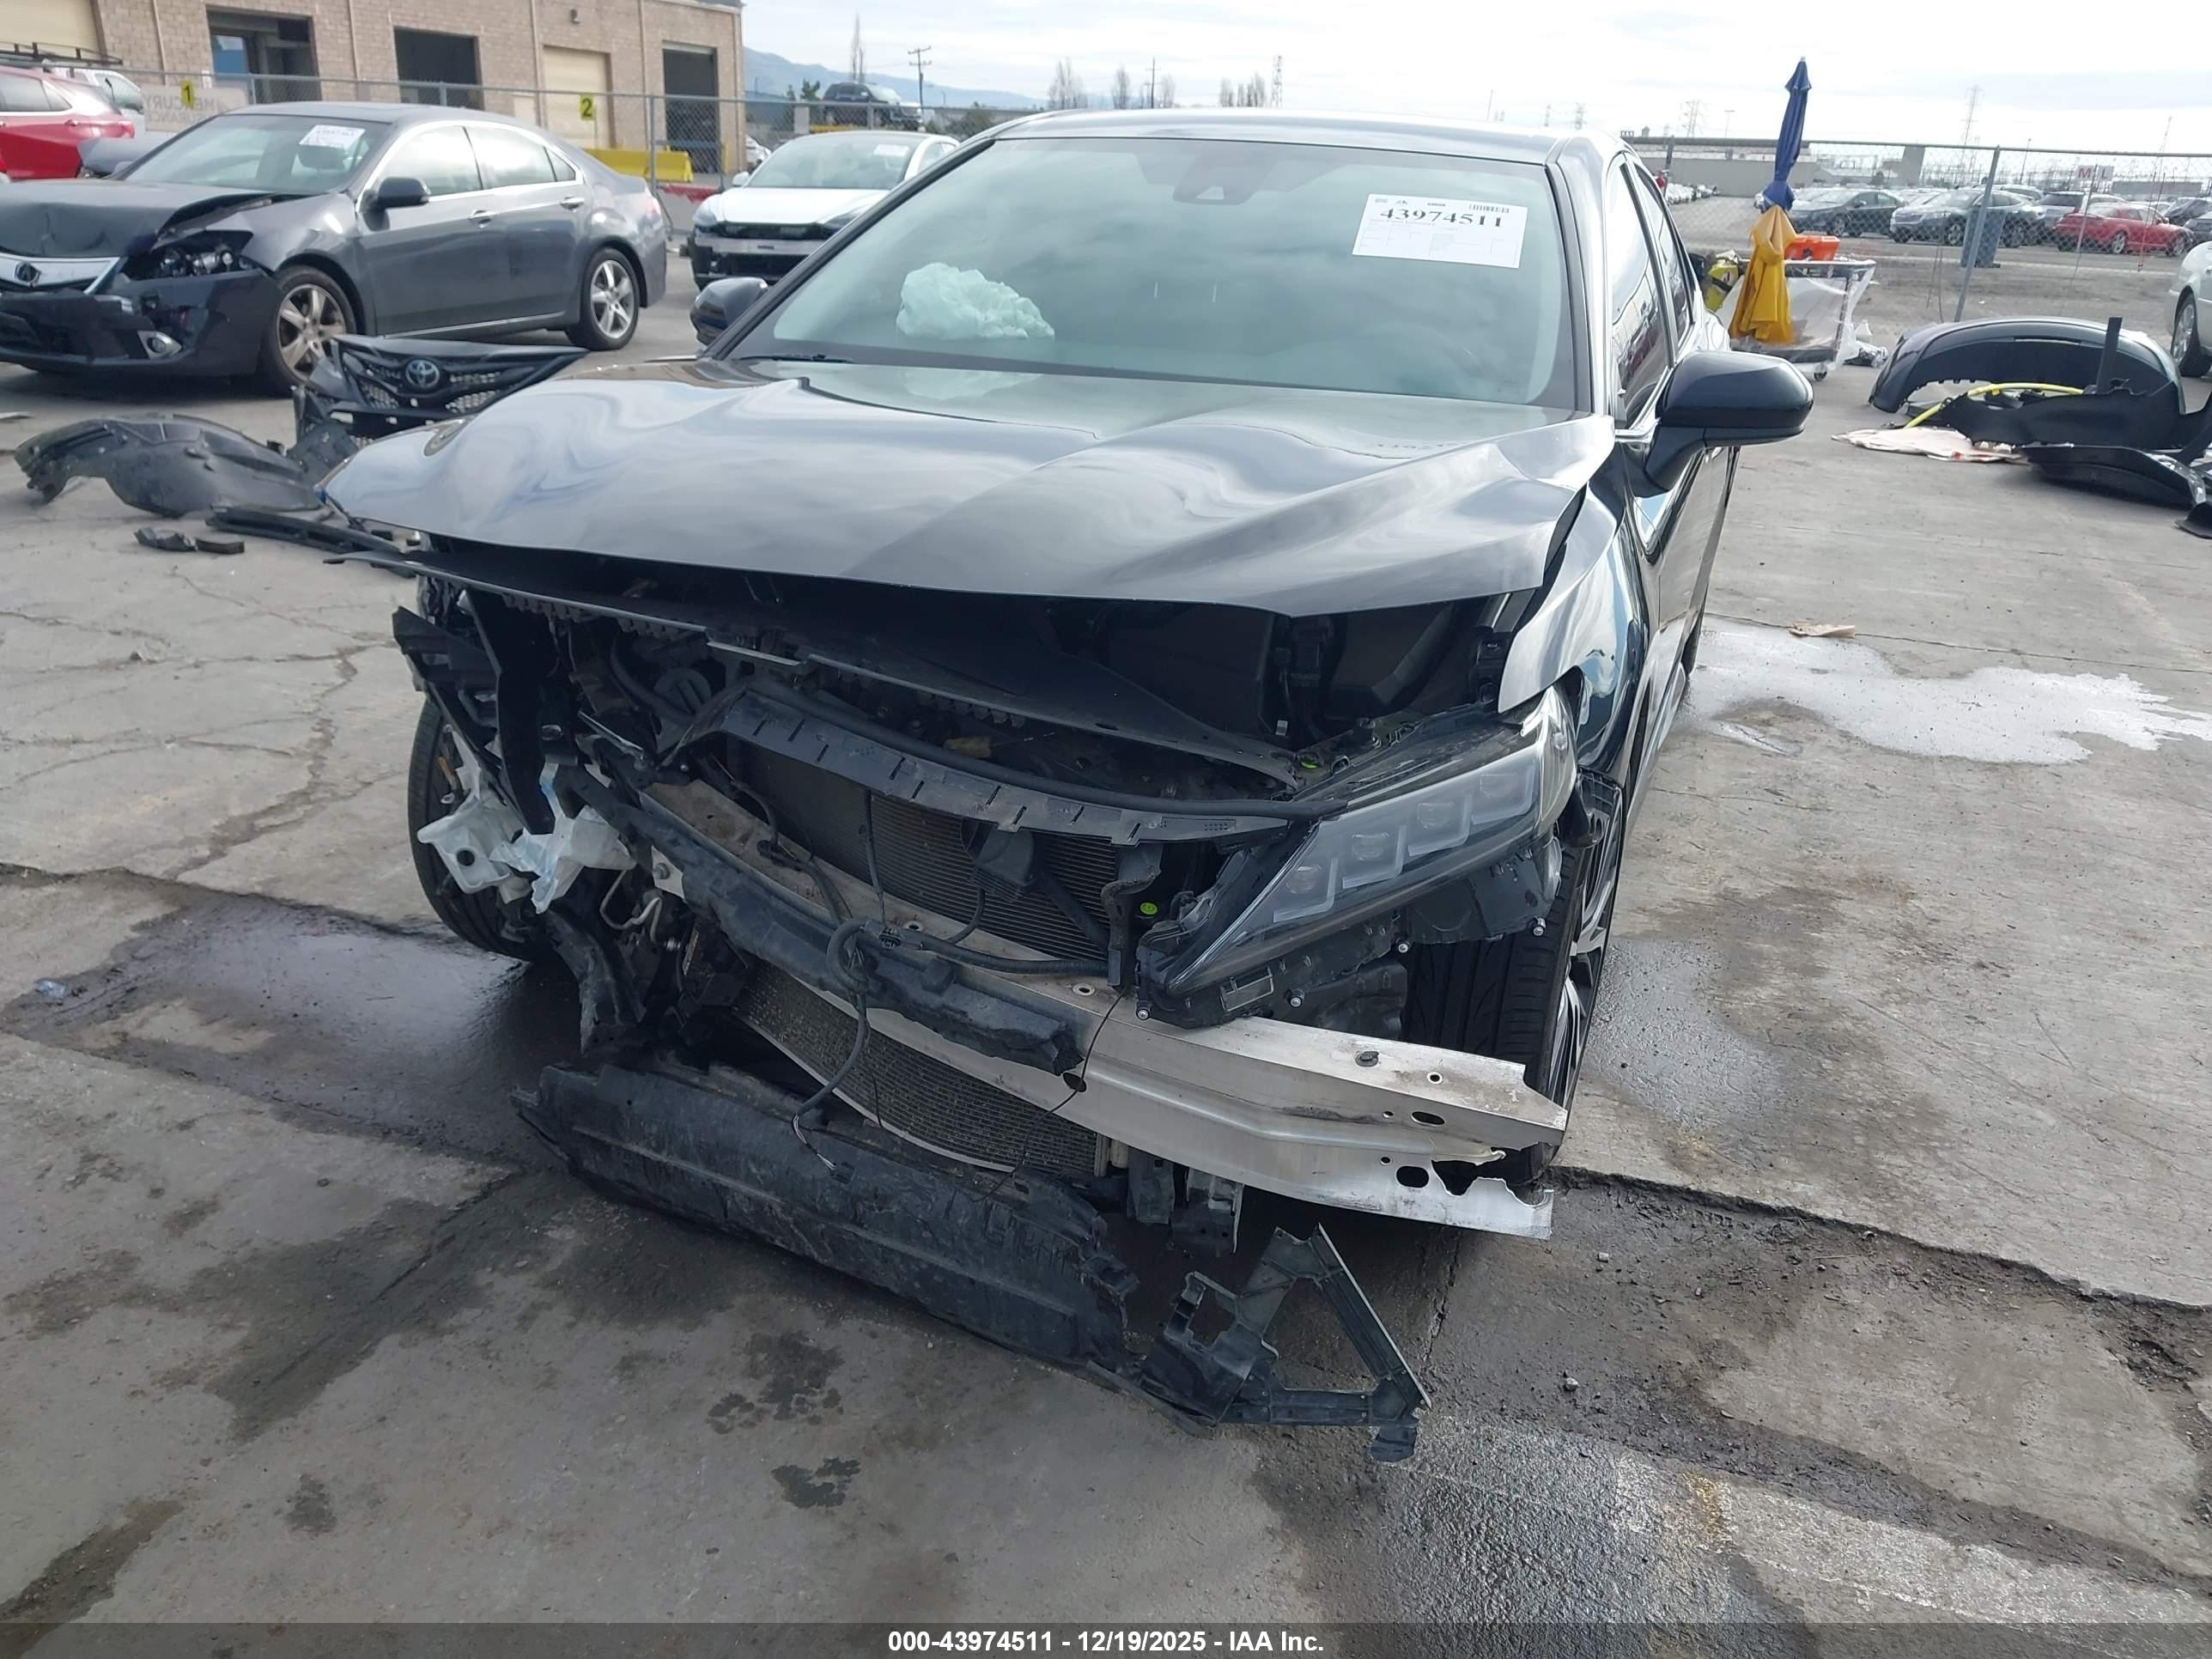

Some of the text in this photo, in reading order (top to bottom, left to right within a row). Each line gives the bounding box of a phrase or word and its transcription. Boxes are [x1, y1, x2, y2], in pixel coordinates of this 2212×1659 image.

[184, 84, 191, 102] 1
[581, 97, 592, 118] 2
[2078, 167, 2092, 179] M
[2100, 167, 2109, 179] L
[1380, 207, 1502, 228] 43974511
